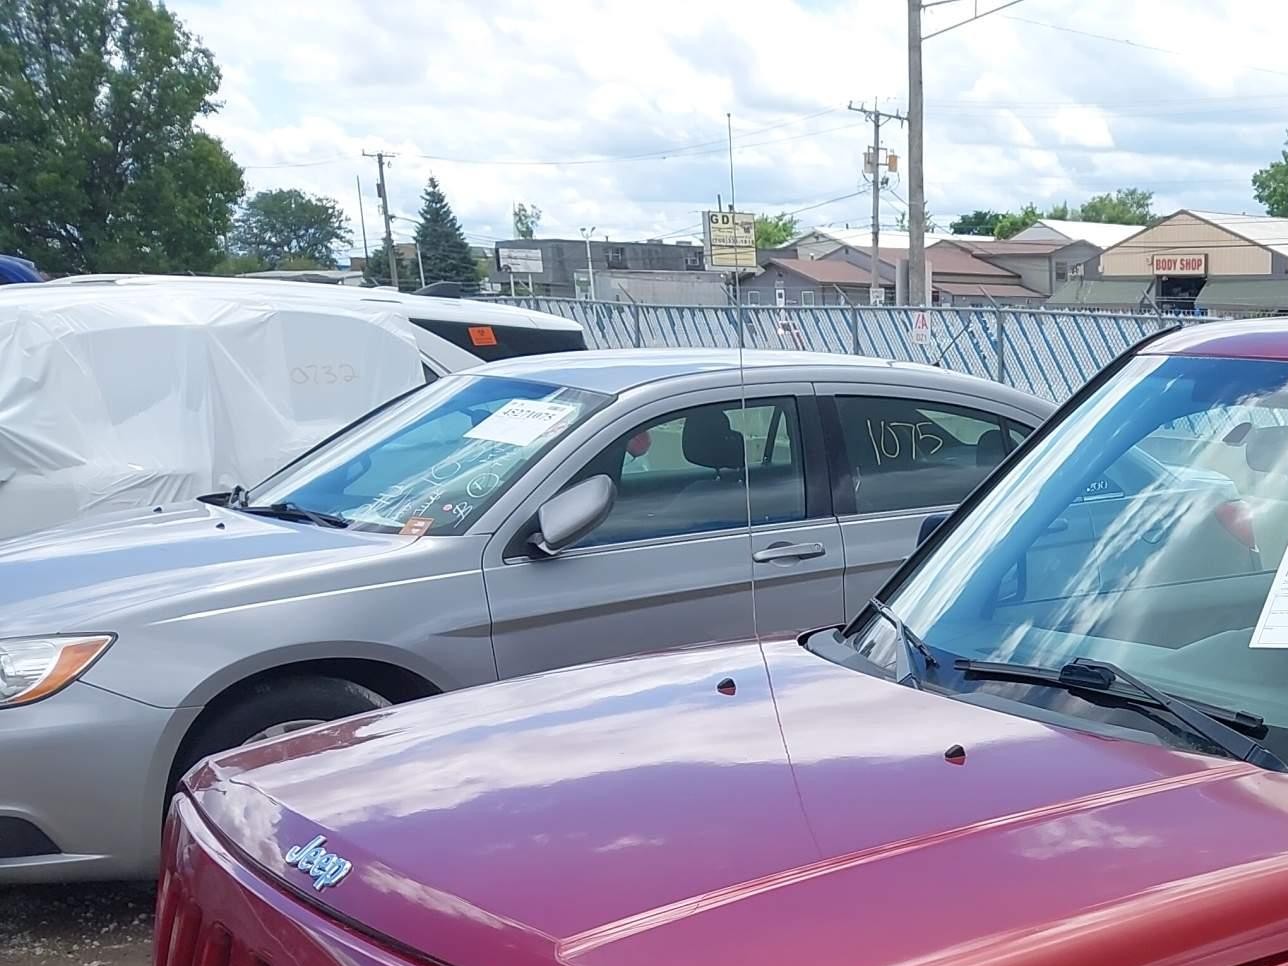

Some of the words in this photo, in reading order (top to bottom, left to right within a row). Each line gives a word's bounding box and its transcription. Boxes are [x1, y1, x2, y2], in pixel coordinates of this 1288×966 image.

[1155, 257, 1178, 271] BODY
[1179, 257, 1203, 271] SHOP
[866, 419, 943, 465] 1075
[285, 834, 353, 891] Jeep
